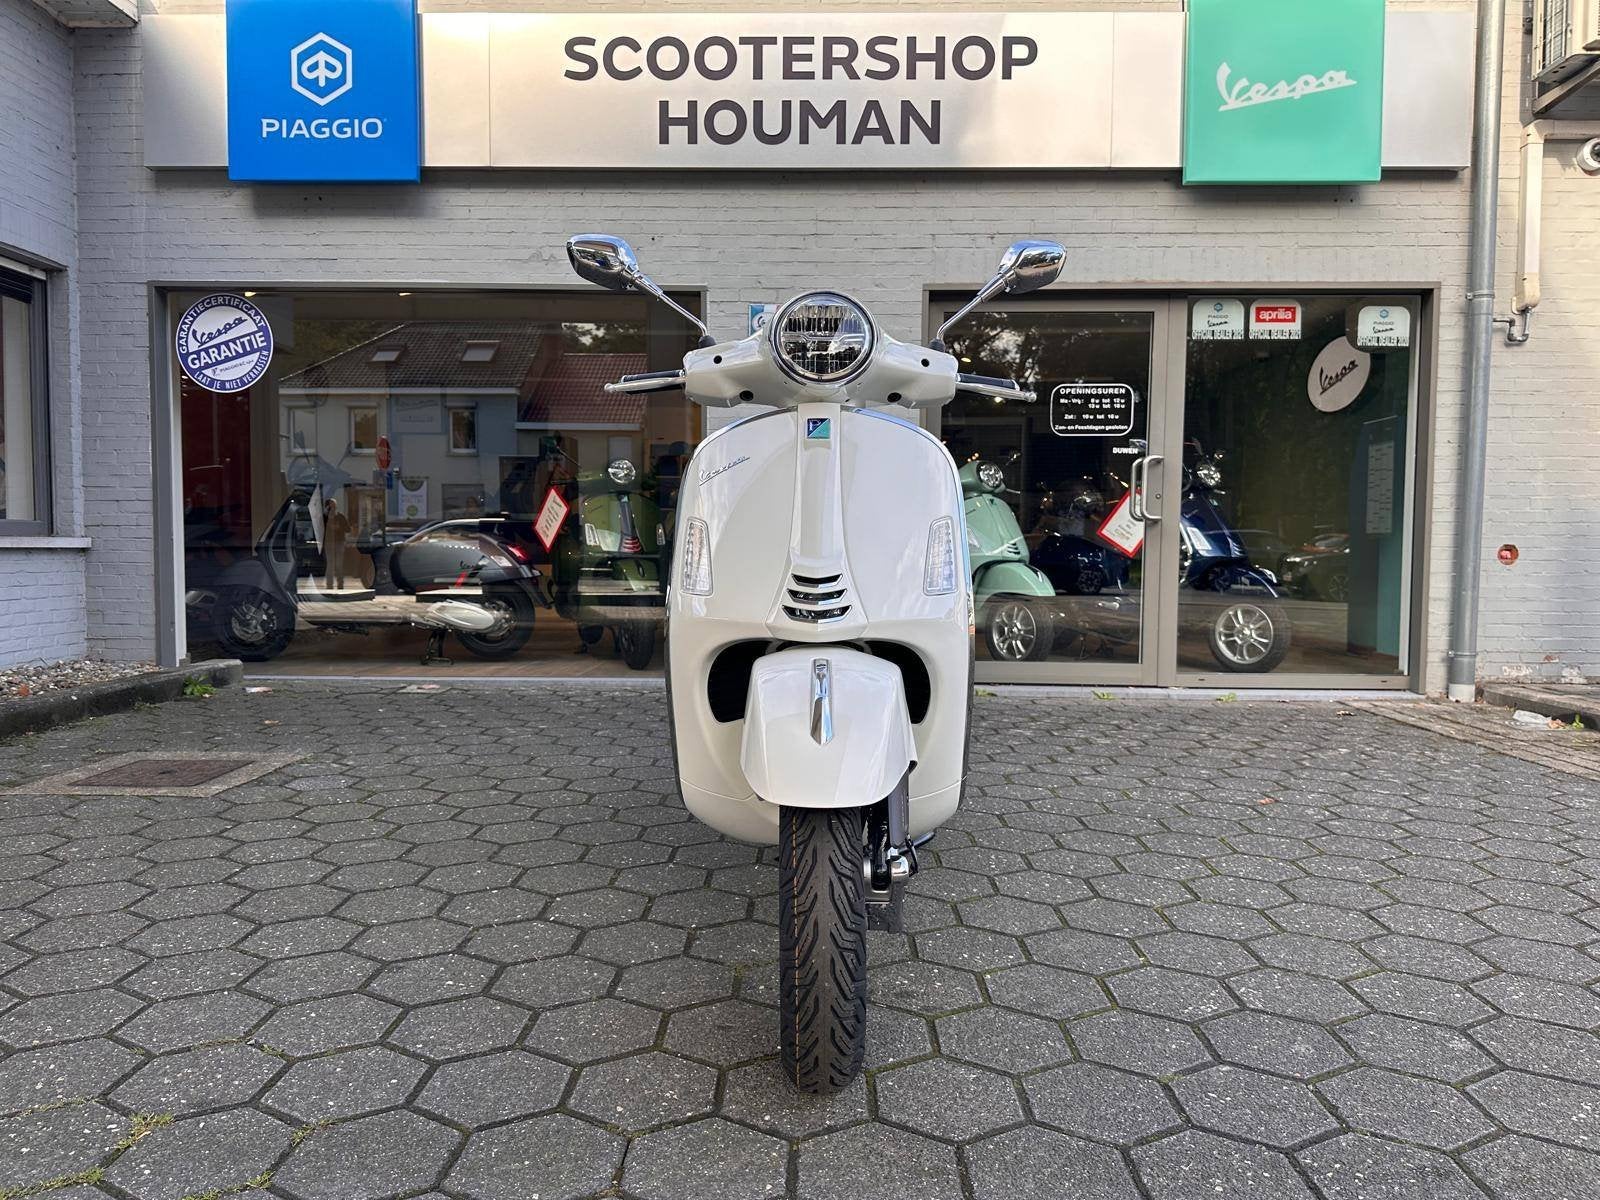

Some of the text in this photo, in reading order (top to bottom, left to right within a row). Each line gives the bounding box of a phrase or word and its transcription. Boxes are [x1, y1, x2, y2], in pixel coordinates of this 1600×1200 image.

[563, 36, 1038, 81] SCOOTERSHOP
[1217, 61, 1358, 112] Vespa
[261, 118, 383, 139] PIAGGIO
[658, 99, 942, 145] HOUMAN
[180, 296, 266, 354] GARANTIECERTIFICAAT
[191, 316, 248, 348] Vespa
[1259, 308, 1292, 321] aprilia
[187, 331, 267, 369] GARANTIE
[194, 350, 270, 390] LAAT JE NIET VERRASSEN
[1318, 358, 1359, 396] Vespa
[1059, 387, 1126, 395] OPENINGSUREN
